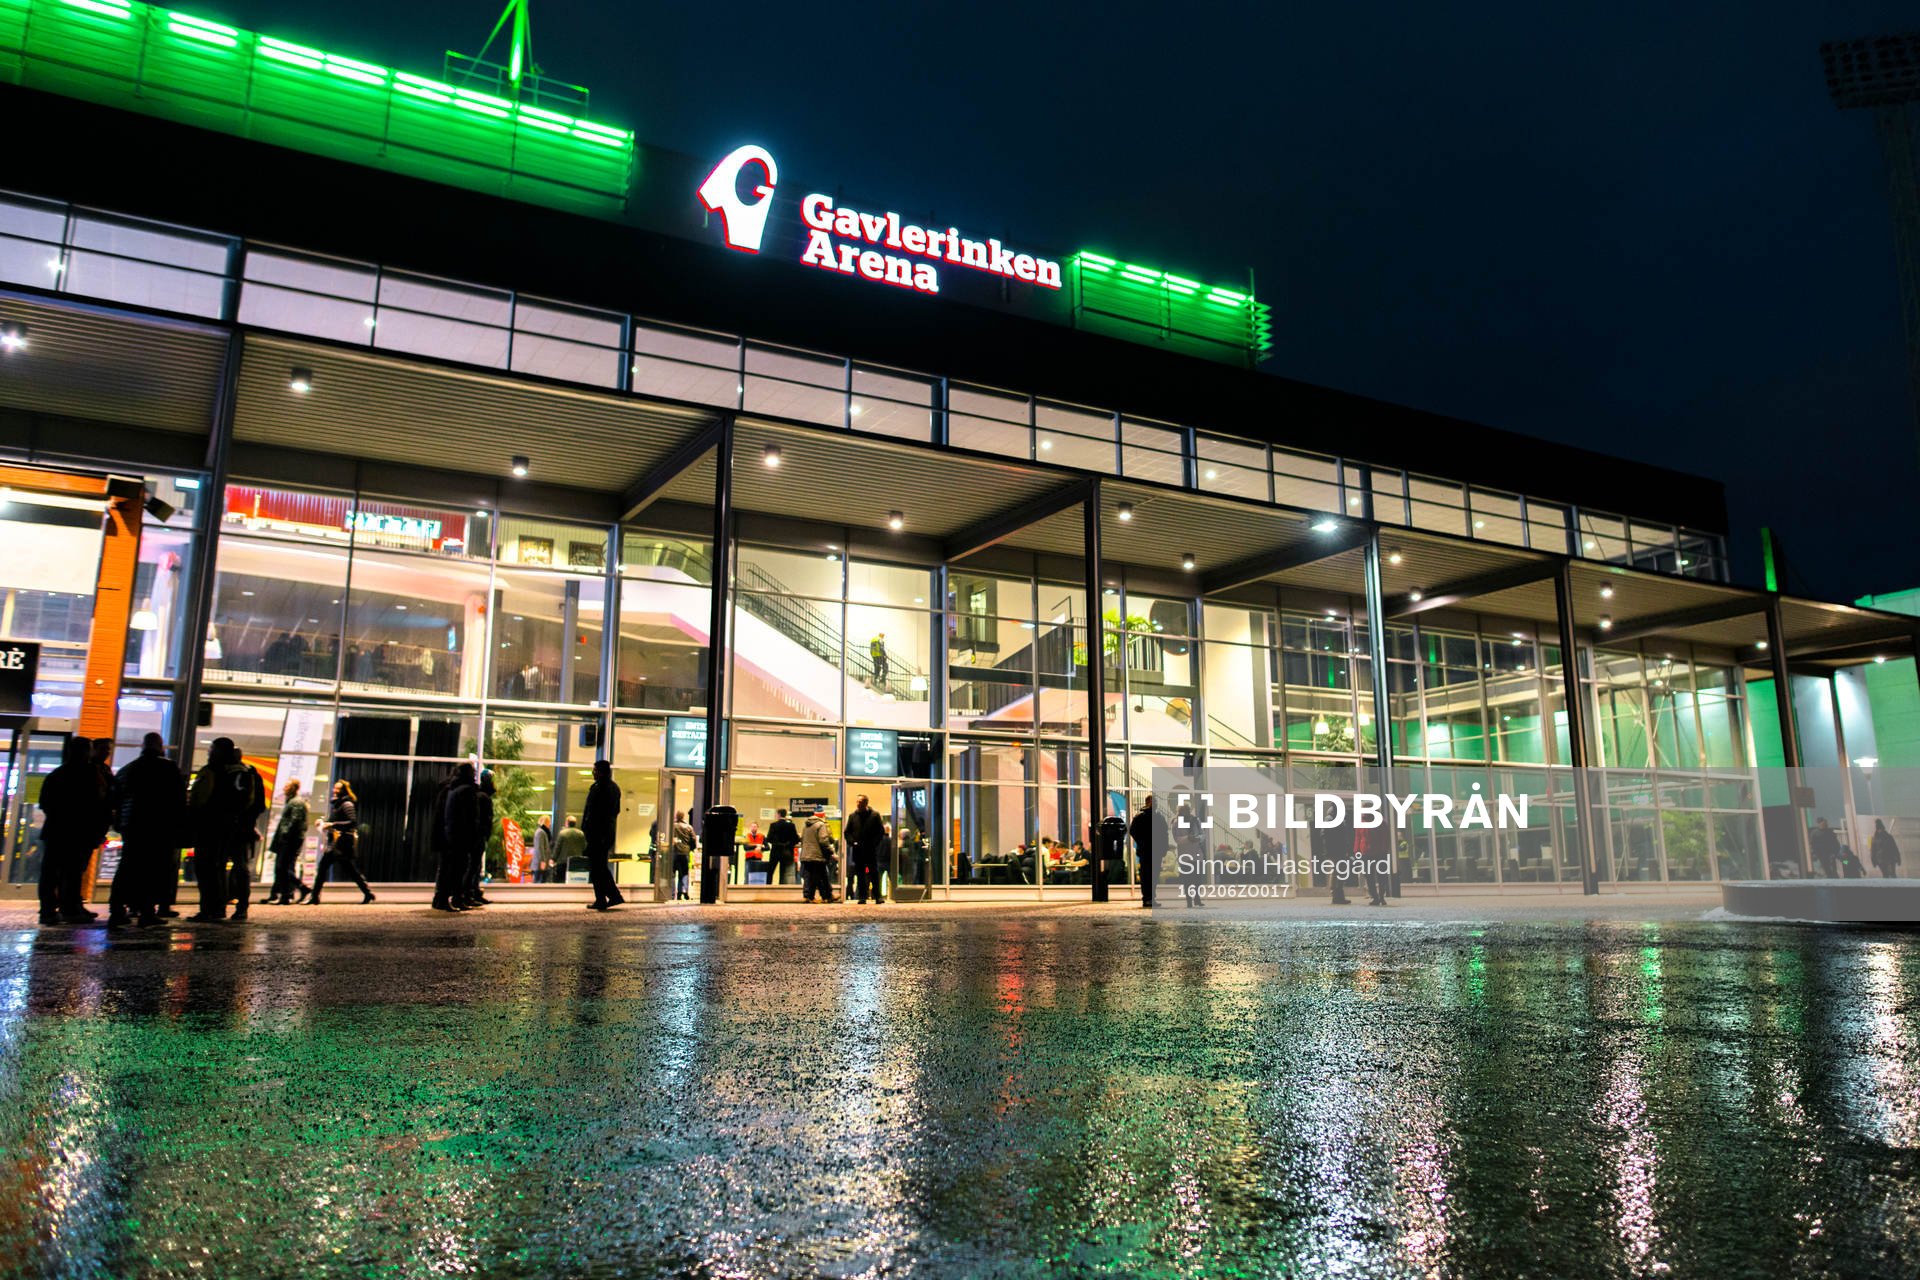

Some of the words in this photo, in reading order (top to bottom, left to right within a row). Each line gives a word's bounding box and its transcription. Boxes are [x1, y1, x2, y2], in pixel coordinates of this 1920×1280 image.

[801, 193, 1062, 290] Gavlerinken
[801, 229, 940, 295] Arena
[687, 742, 706, 766] 4
[864, 751, 879, 774] 5
